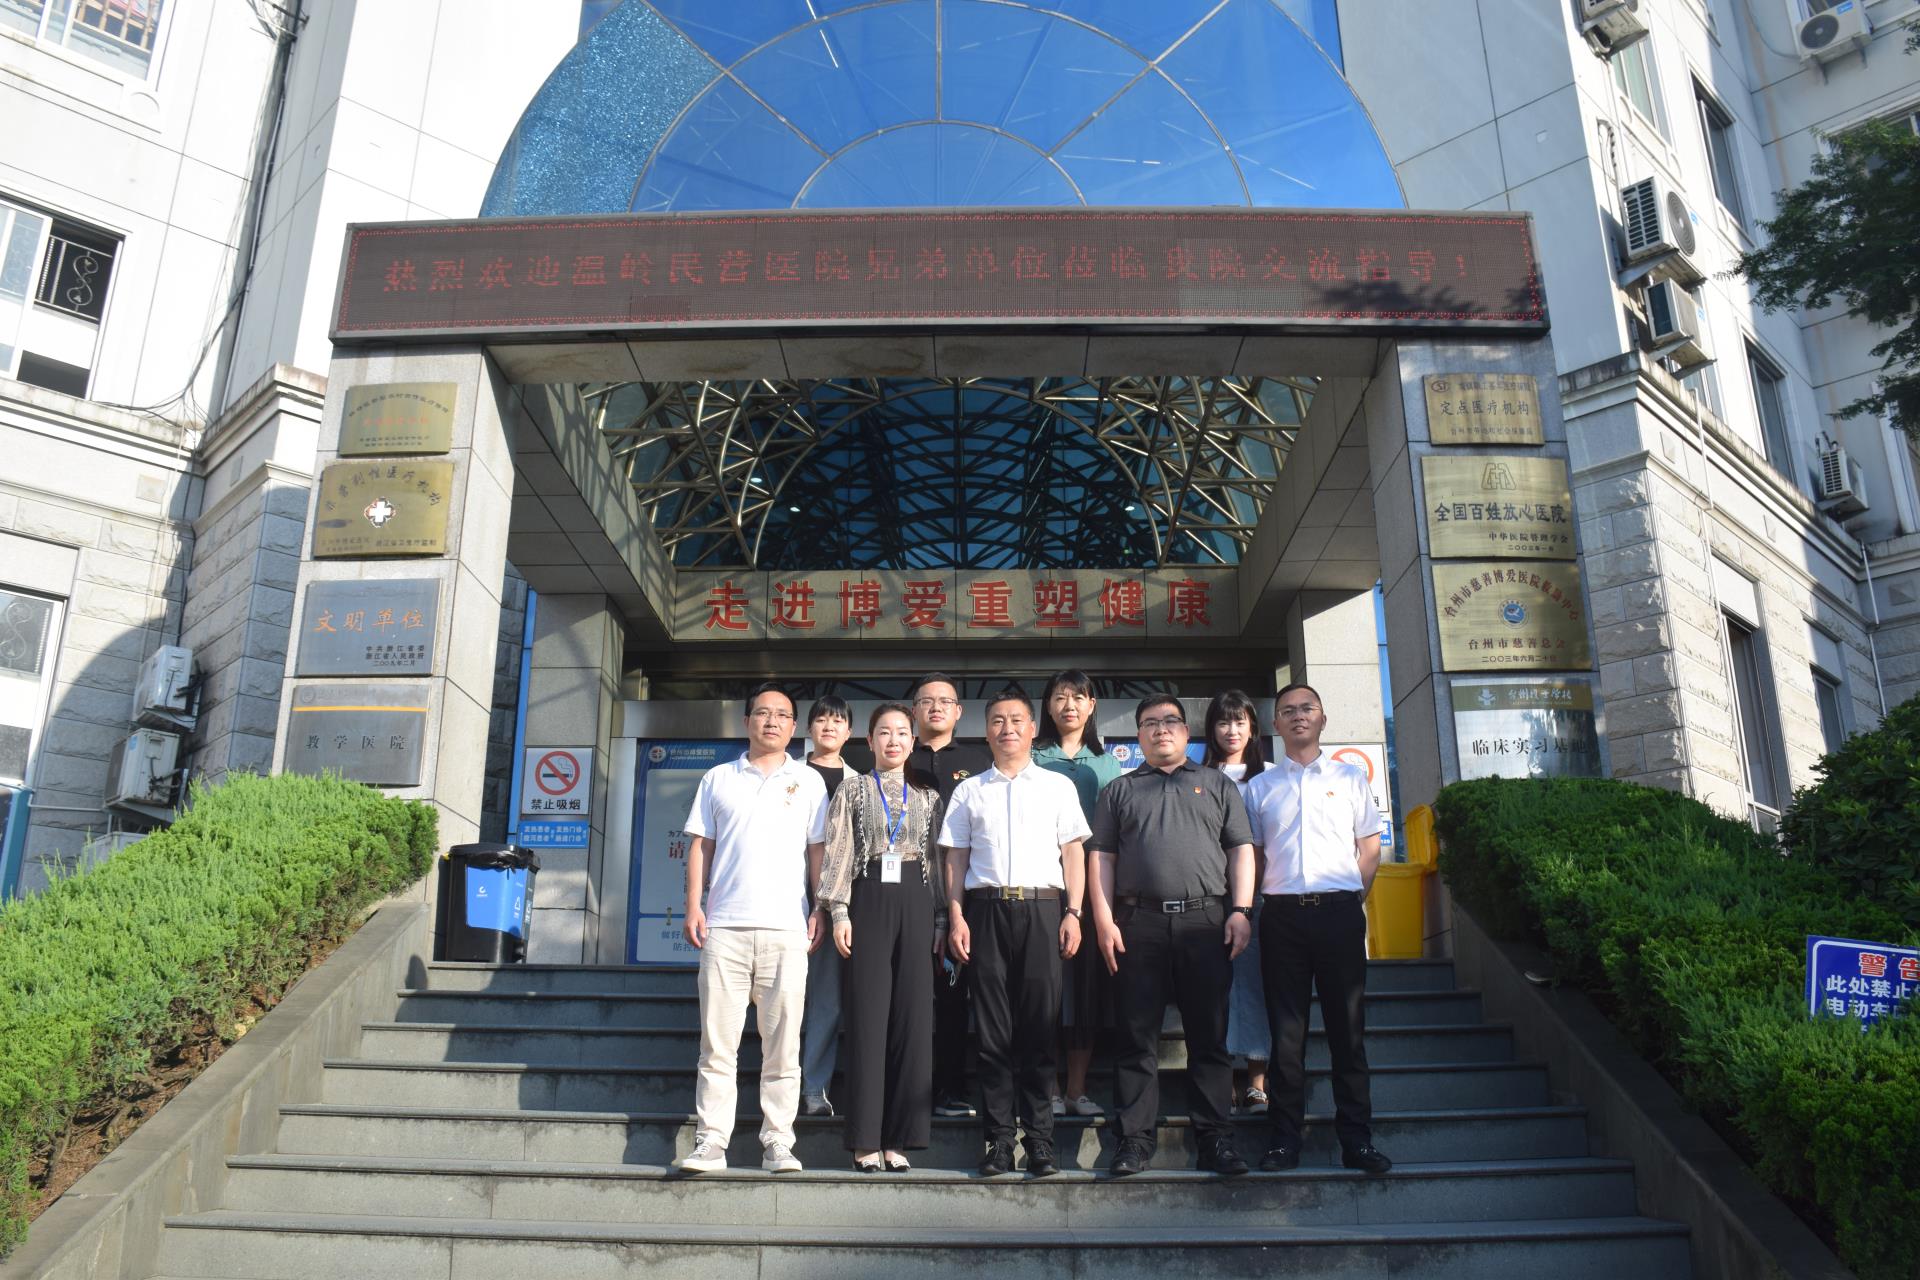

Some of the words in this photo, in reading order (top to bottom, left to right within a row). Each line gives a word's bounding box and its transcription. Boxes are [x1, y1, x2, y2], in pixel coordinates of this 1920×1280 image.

[1440, 400, 1529, 416] 定点医疗机构
[1434, 502, 1567, 524] 全国百姓放心医院
[704, 578, 1213, 631] 走进博爱重塑健康
[1468, 637, 1566, 650] 台州市慈善总会
[306, 734, 408, 750] 教学医院
[1472, 737, 1586, 757] 临床实习基地
[531, 798, 581, 810] 禁止吸烟
[1858, 952, 1920, 980] 警告
[1825, 974, 1920, 999] 此处禁止
